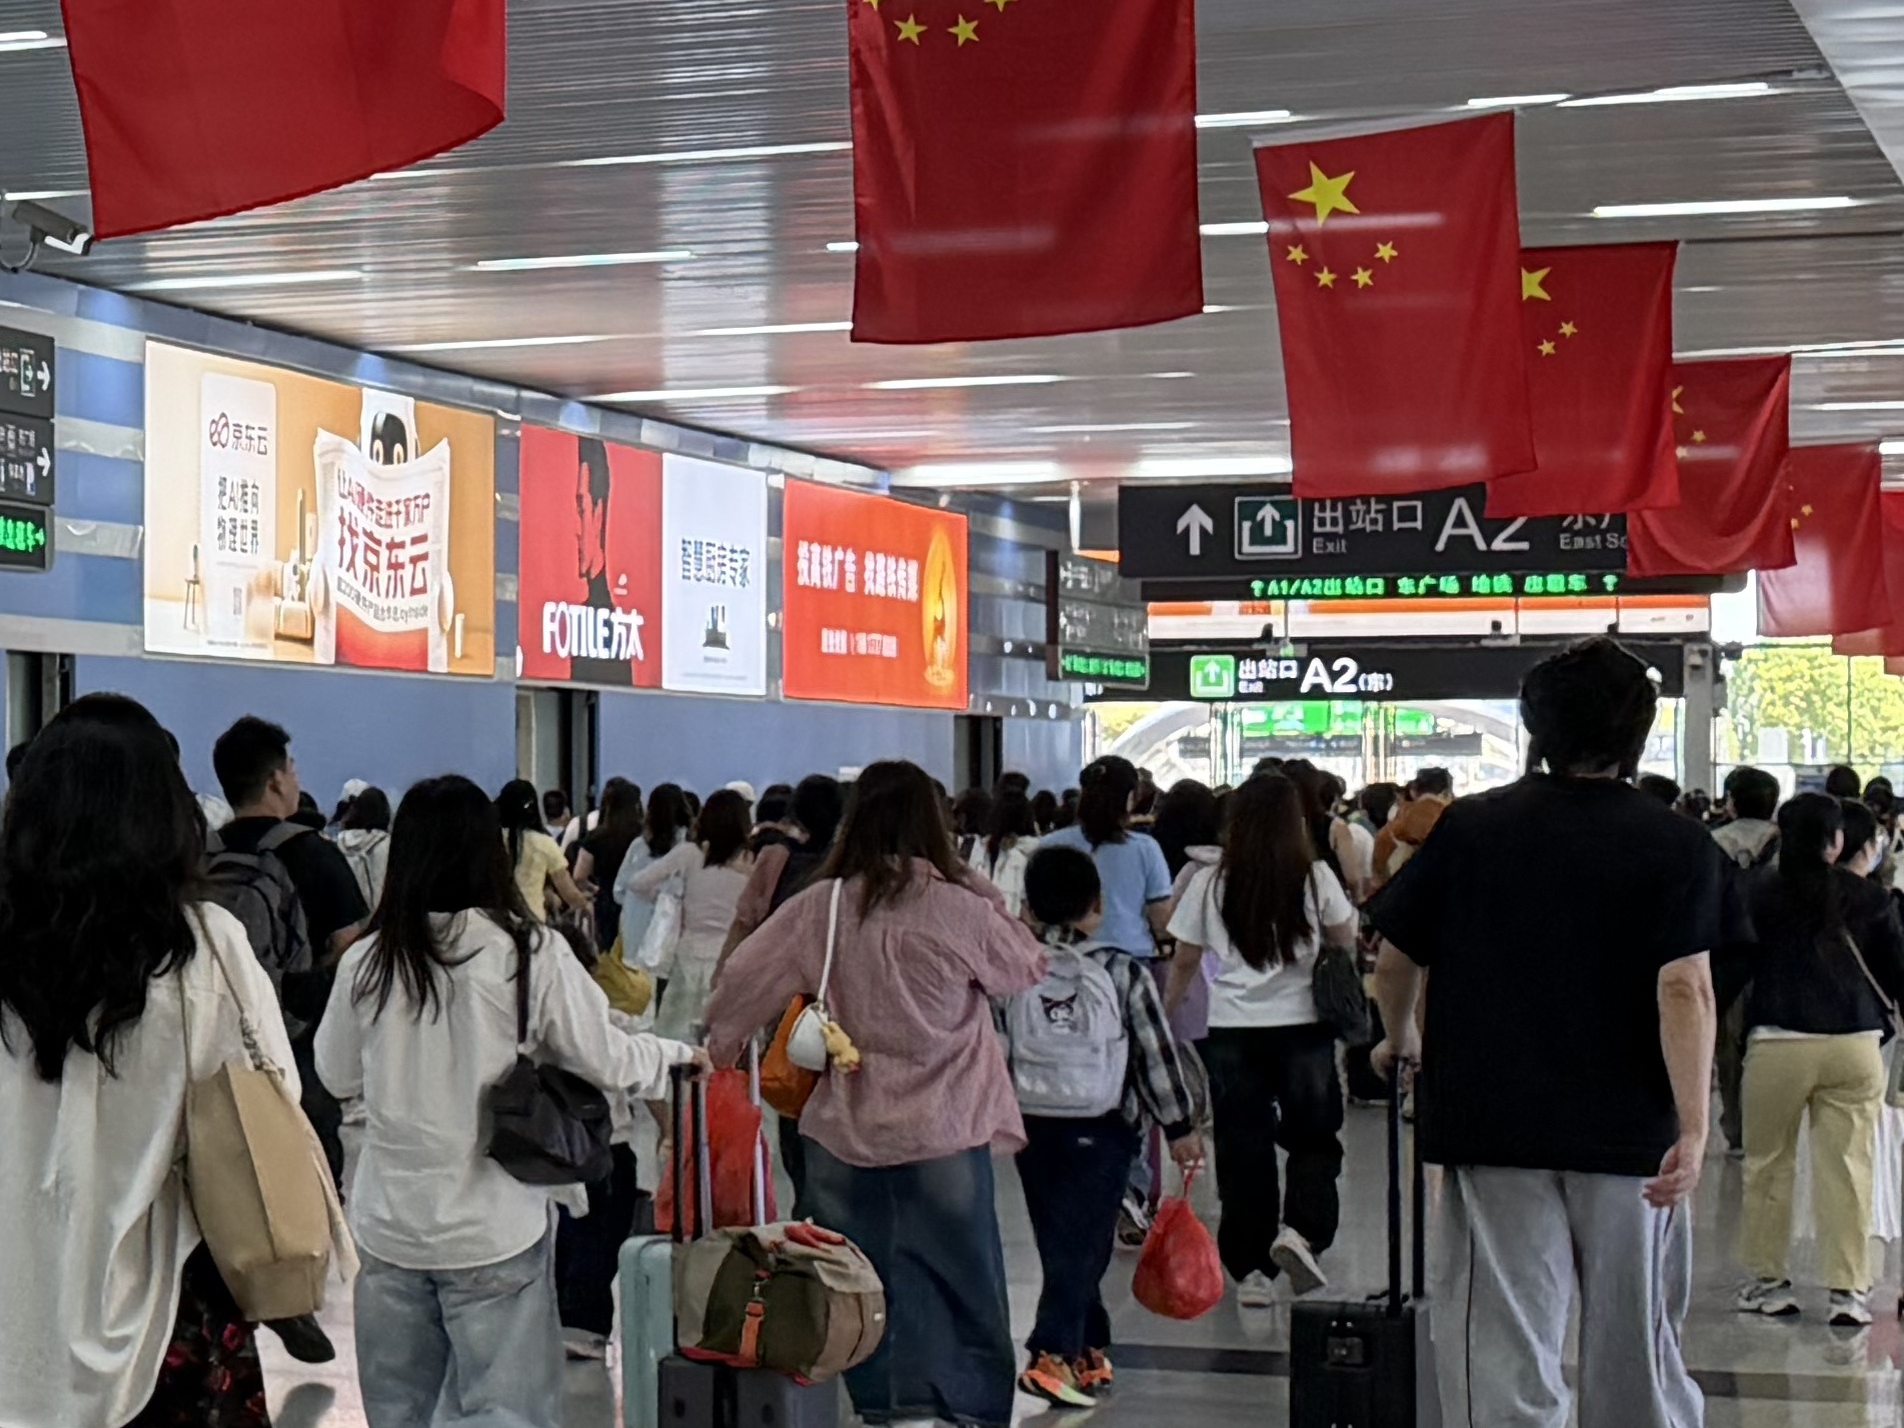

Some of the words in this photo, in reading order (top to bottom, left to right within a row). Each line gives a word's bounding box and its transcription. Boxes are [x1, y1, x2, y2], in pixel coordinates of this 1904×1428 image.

[232, 423, 267, 455] 京东云
[1313, 497, 1422, 535] 出站口
[338, 506, 429, 599] 找京东云
[1313, 539, 1347, 554] Exit
[1238, 658, 1297, 679] 出站口
